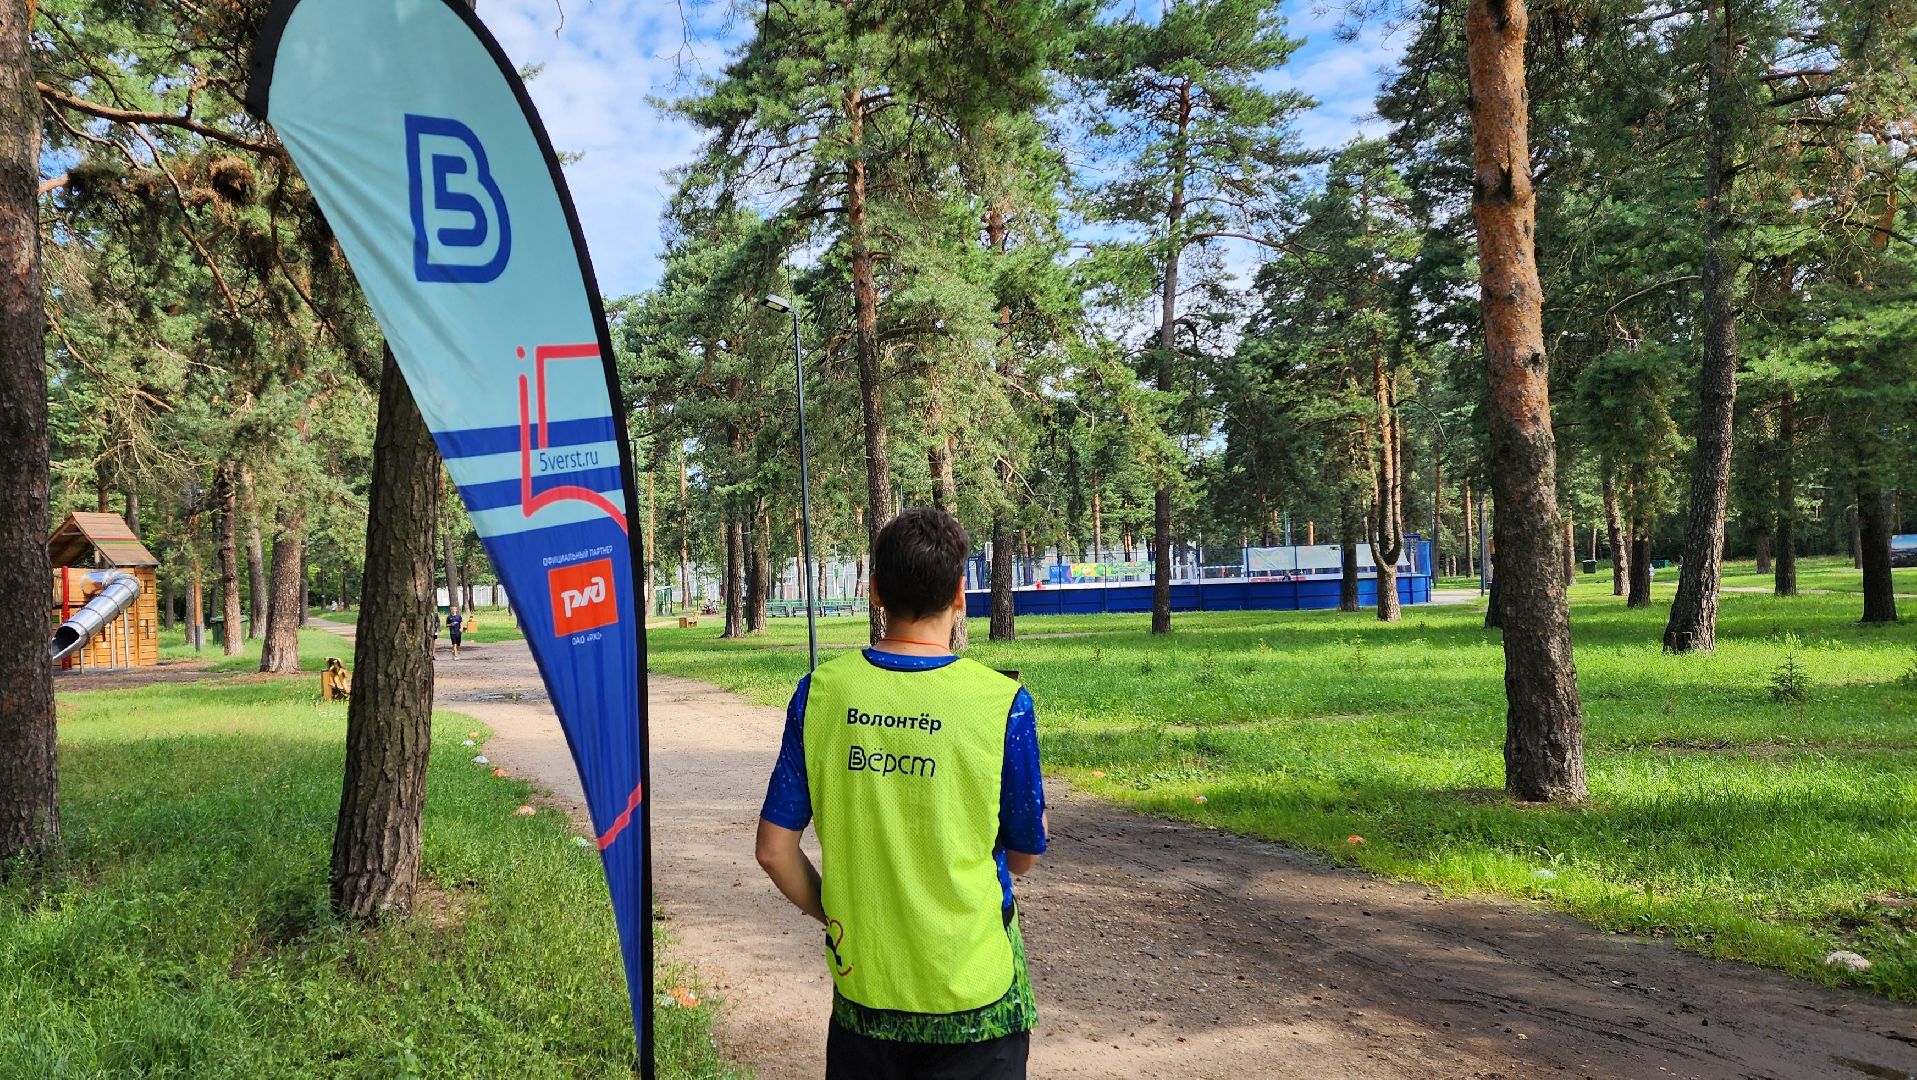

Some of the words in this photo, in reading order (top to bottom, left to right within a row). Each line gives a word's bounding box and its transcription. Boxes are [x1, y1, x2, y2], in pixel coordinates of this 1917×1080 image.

[539, 449, 599, 473] 5verst.ru
[542, 548, 588, 567] ОФИЦИАЛЬНЫЙ
[589, 545, 613, 557] ПАРТНЕР
[572, 635, 585, 645] ОАО
[847, 707, 942, 735] Волонтёр
